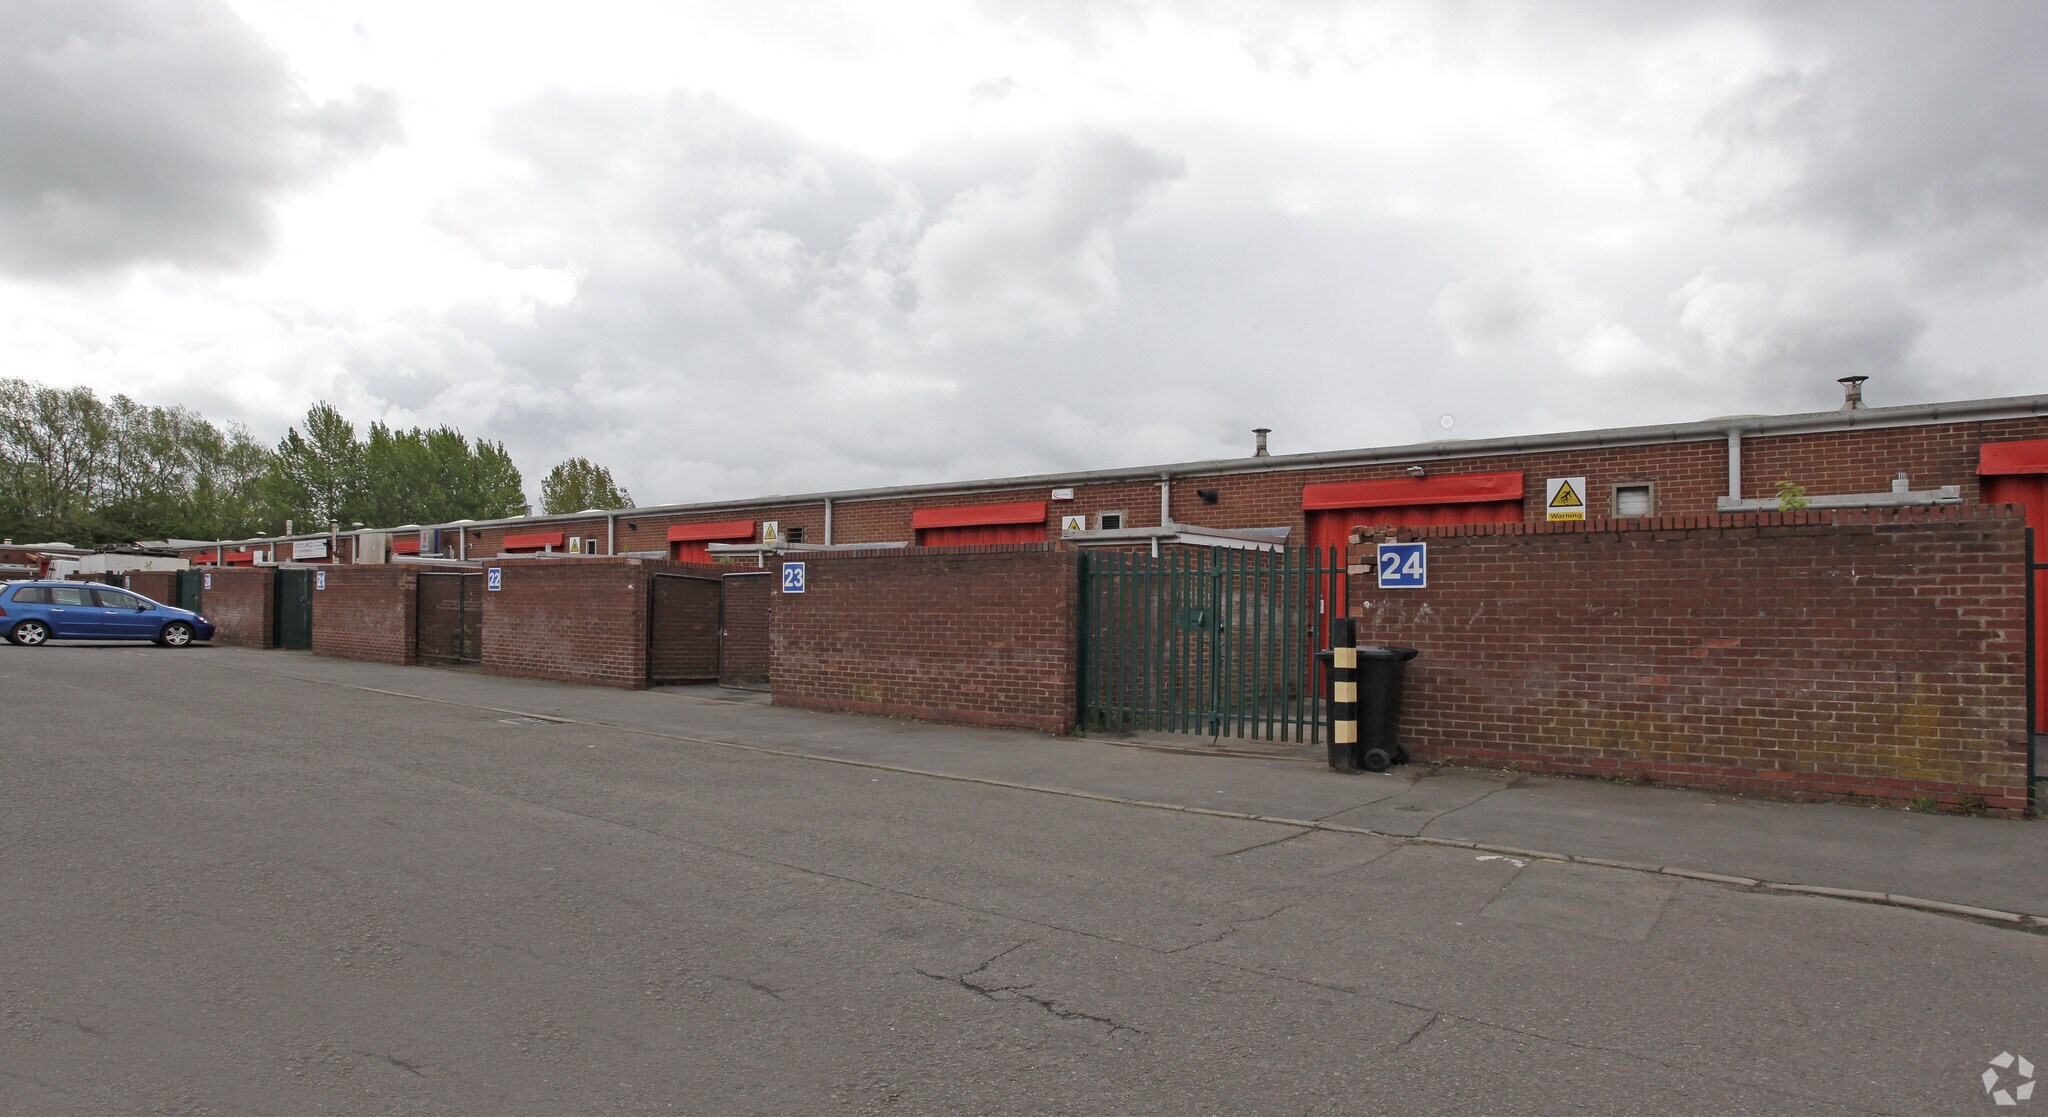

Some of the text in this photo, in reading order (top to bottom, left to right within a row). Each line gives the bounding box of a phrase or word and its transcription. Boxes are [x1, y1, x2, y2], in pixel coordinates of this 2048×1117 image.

[1381, 552, 1423, 580] 24
[489, 572, 500, 586] 22
[784, 568, 803, 587] 23
